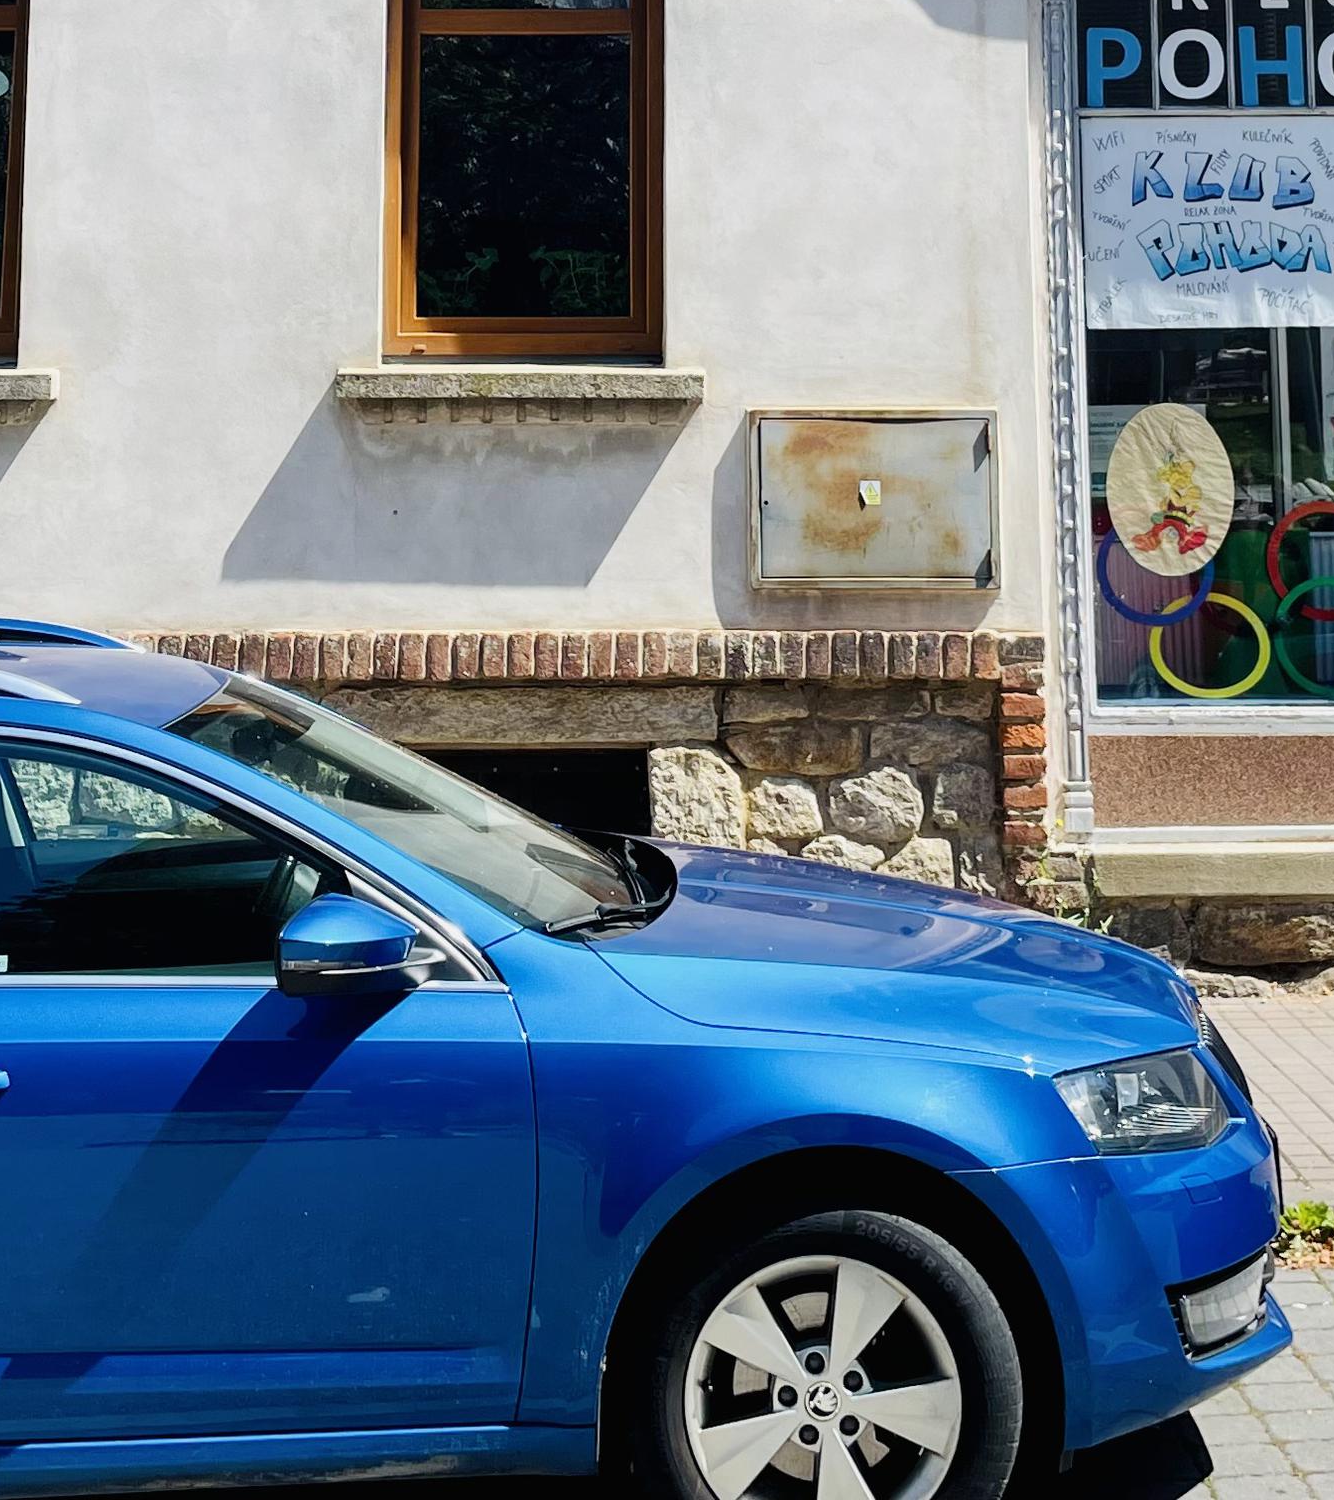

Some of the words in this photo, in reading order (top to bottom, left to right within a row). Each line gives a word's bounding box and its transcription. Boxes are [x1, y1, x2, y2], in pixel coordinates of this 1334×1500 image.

[1092, 130, 1125, 152] WIFI
[1093, 164, 1122, 195] SPORT
[1132, 150, 1315, 210] KLUB
[1135, 219, 1333, 282] POHODA
[856, 1219, 922, 1259] 205/55
